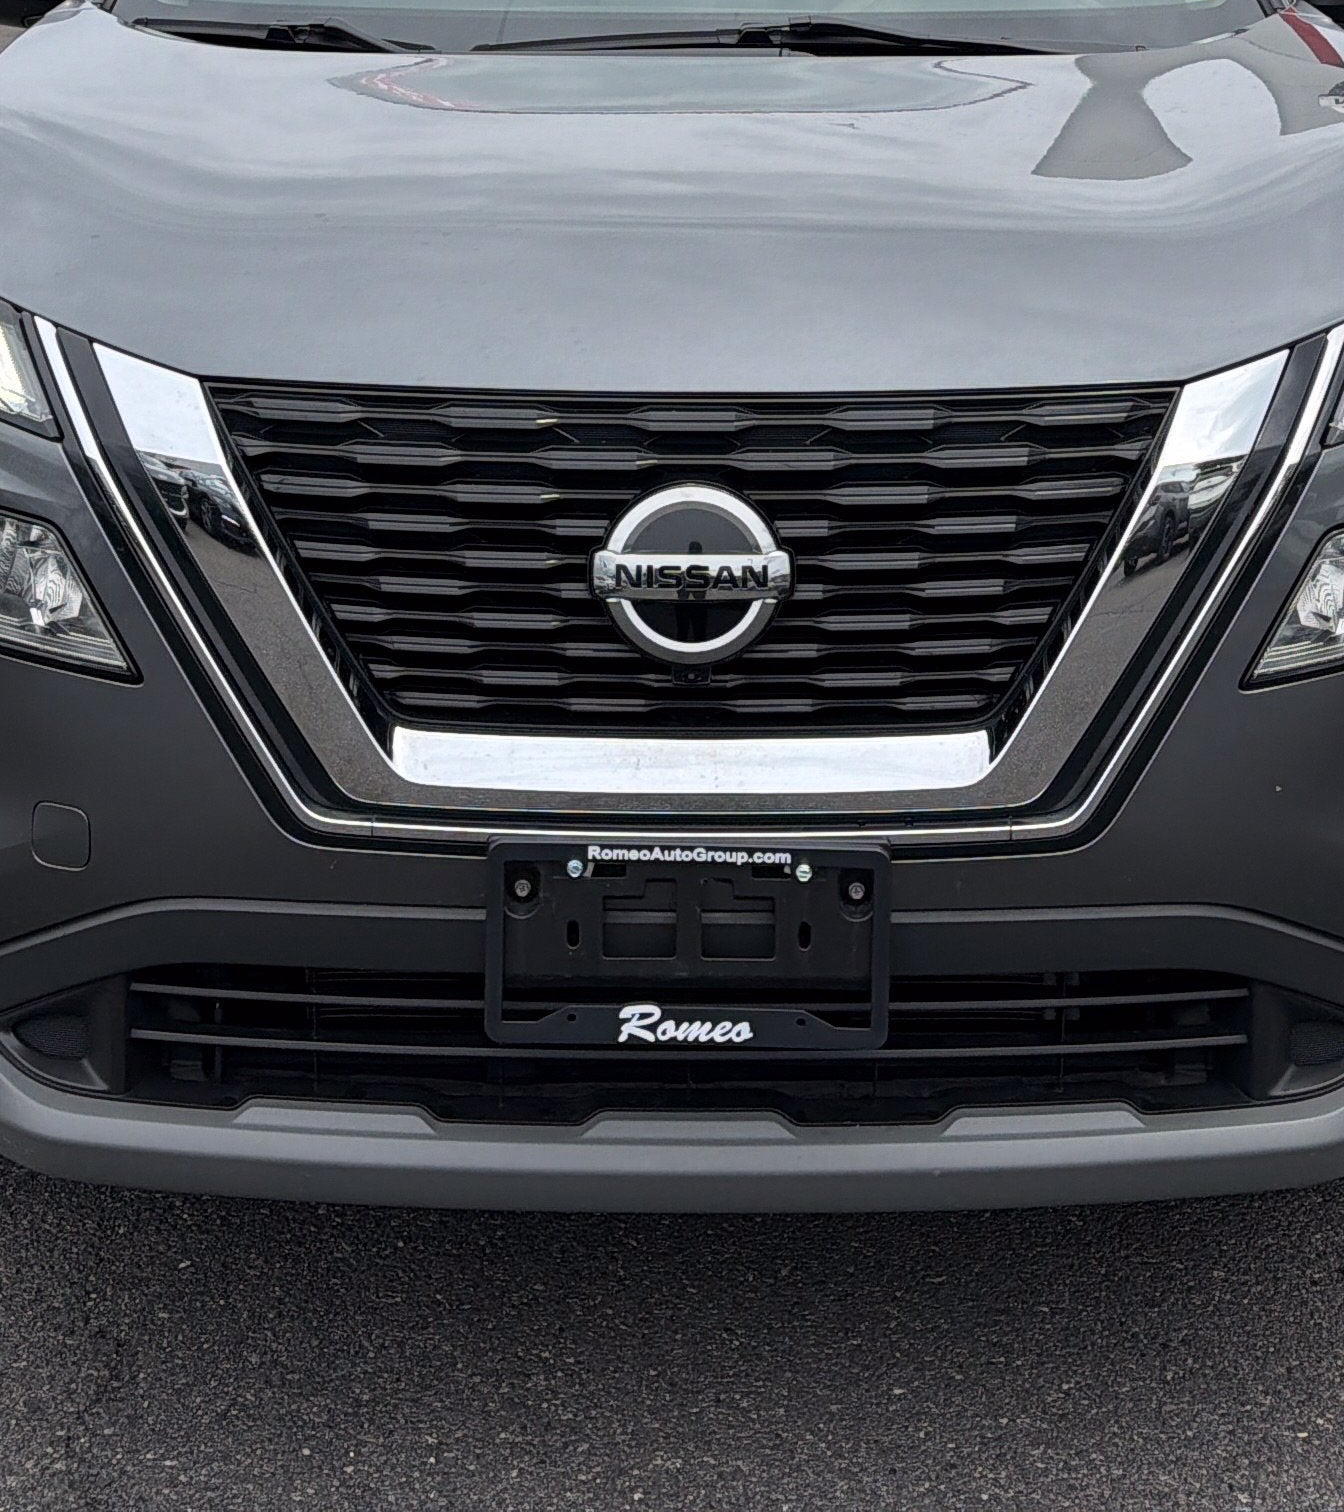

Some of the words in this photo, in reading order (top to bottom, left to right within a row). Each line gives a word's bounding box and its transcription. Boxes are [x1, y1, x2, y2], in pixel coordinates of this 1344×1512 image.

[615, 563, 768, 589] NISSAN
[587, 845, 792, 865] RomeoAutoGroup.com
[617, 1004, 754, 1043] Romeo
